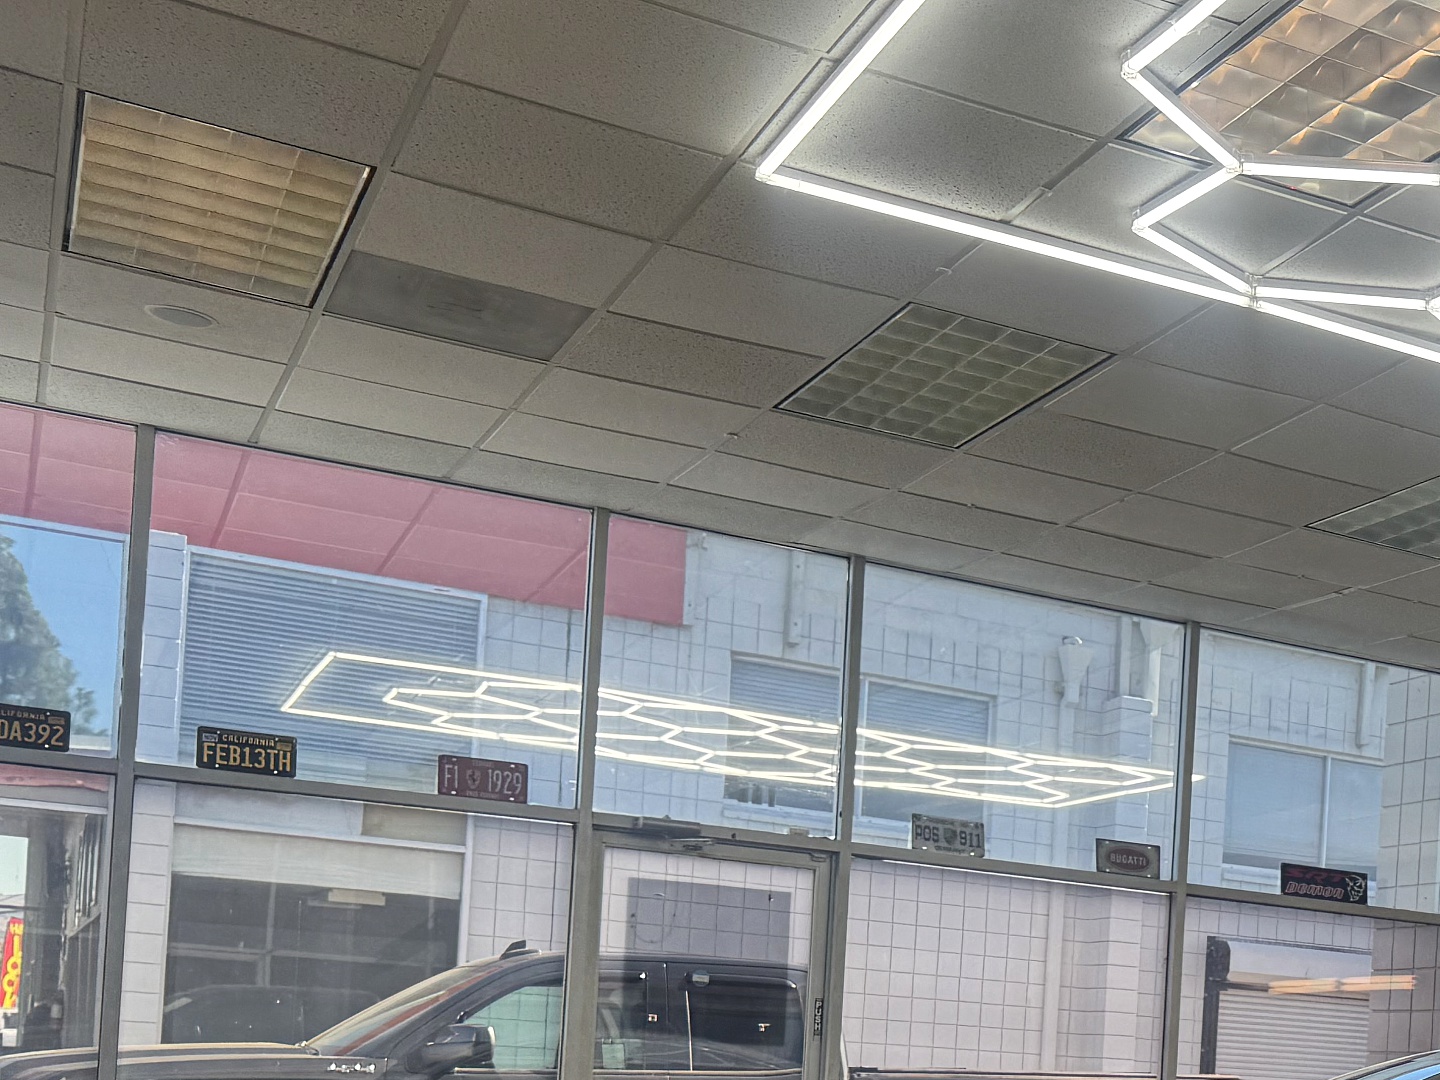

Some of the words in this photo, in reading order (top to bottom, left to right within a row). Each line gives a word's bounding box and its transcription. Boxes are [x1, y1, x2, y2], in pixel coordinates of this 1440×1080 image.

[0, 709, 45, 720] LIFORNIA
[222, 734, 275, 747] CALIFORNIA
[203, 742, 291, 772] FEB13TH
[487, 769, 522, 794] 1929
[959, 830, 981, 848] 911
[1110, 853, 1146, 866] BUGATTI
[815, 1001, 823, 1031] PUSH
